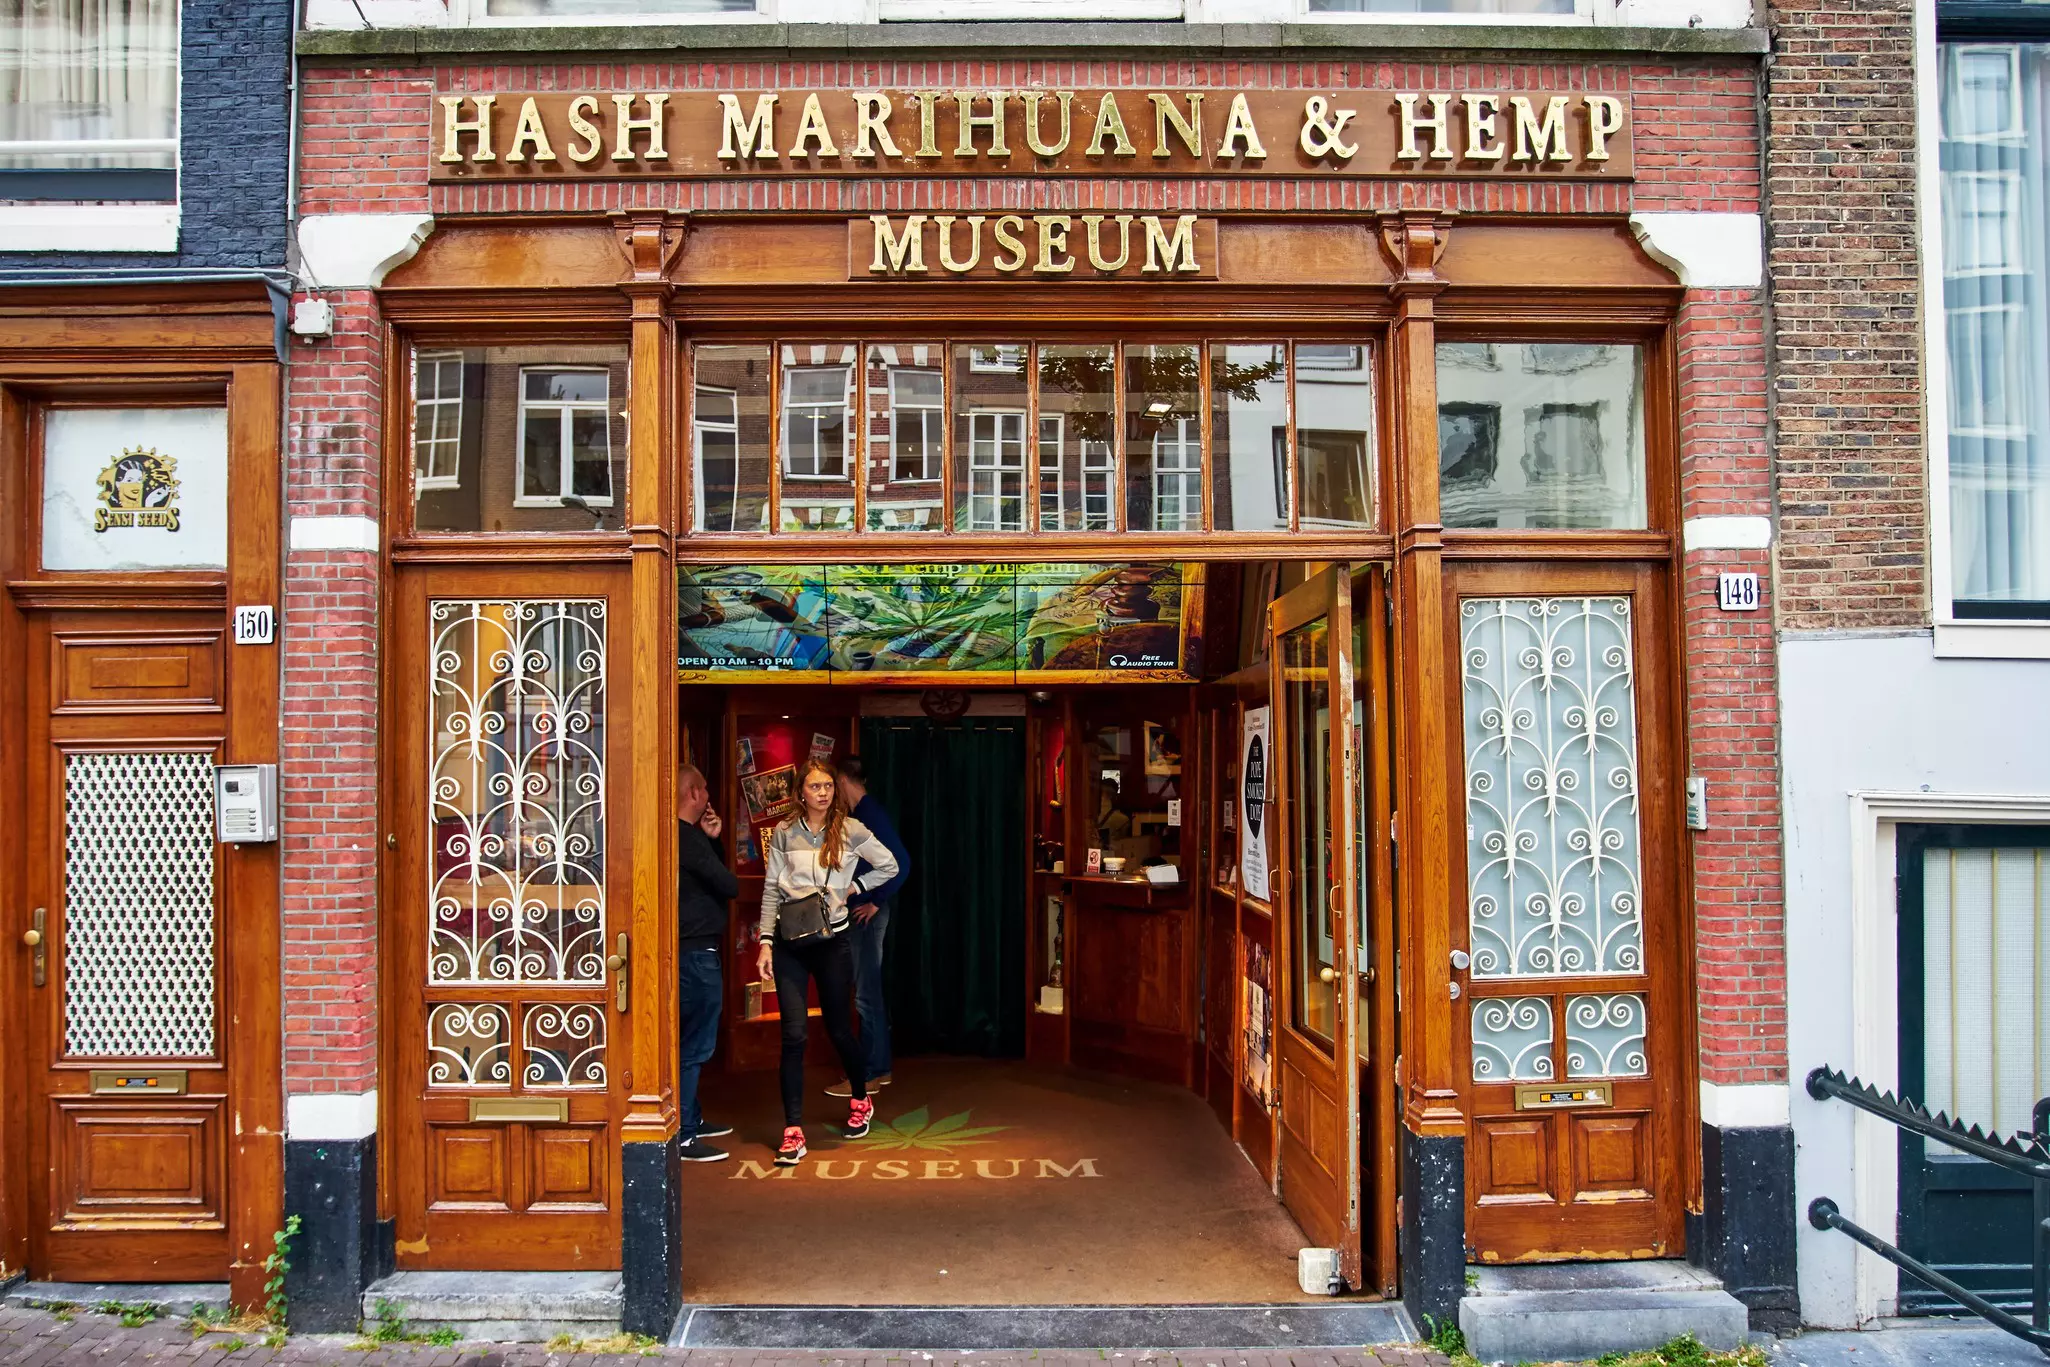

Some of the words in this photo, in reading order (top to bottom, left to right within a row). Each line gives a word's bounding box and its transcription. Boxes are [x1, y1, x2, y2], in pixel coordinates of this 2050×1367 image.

[438, 92, 670, 163] HASH
[717, 91, 1267, 160] MARIHUANA
[1300, 94, 1360, 159] &
[1394, 92, 1624, 162] HEMP
[868, 213, 1201, 273] MUSEUM
[95, 508, 134, 533] SENSI
[138, 508, 180, 532] SEEDS
[1724, 577, 1754, 605] 148
[239, 610, 268, 639] 150
[677, 657, 708, 666] OPEN
[711, 657, 726, 666] 10
[728, 657, 747, 666] AM
[758, 657, 772, 666] 10
[774, 657, 794, 666] PM
[1250, 761, 1262, 778] POPE
[1246, 782, 1264, 800] SMOKES
[1249, 803, 1261, 822] DOPE
[728, 1157, 1104, 1180] MUSEUM
